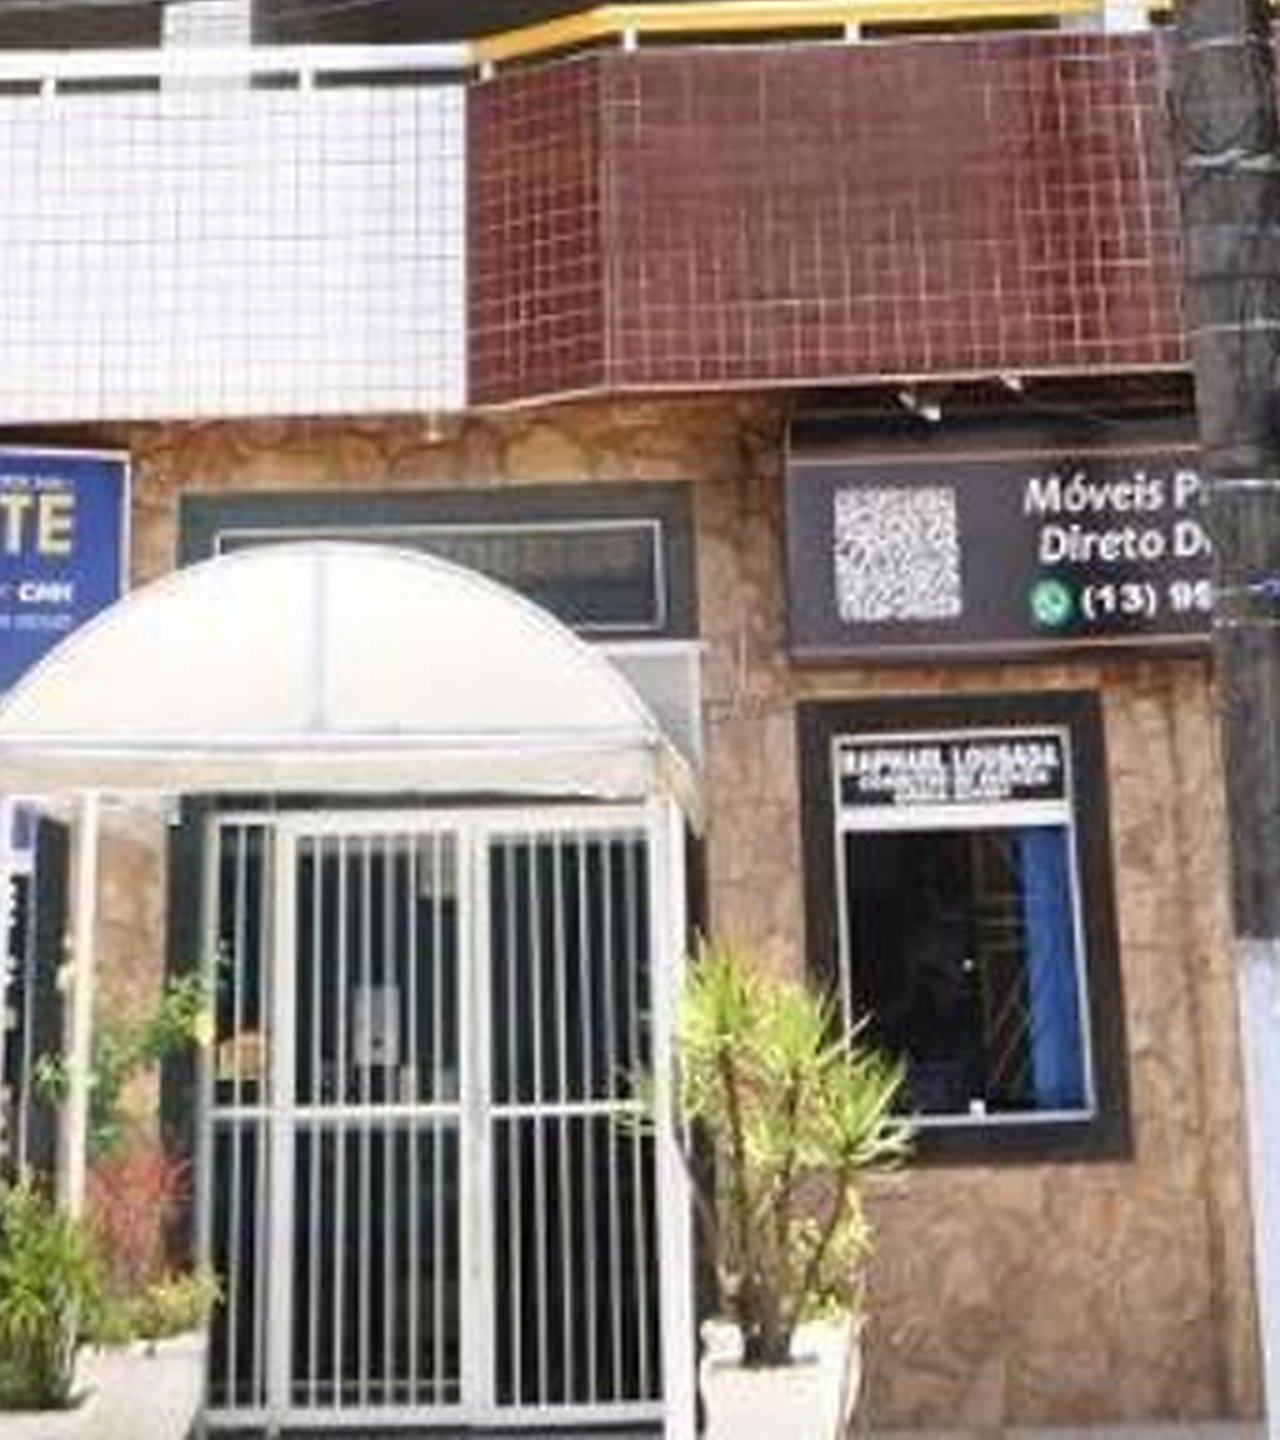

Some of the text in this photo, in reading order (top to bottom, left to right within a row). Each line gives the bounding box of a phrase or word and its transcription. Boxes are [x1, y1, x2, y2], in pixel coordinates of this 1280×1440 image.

[1023, 473, 1166, 516] Móveis
[1039, 525, 1166, 562] Direto
[1081, 581, 1157, 619] (13)
